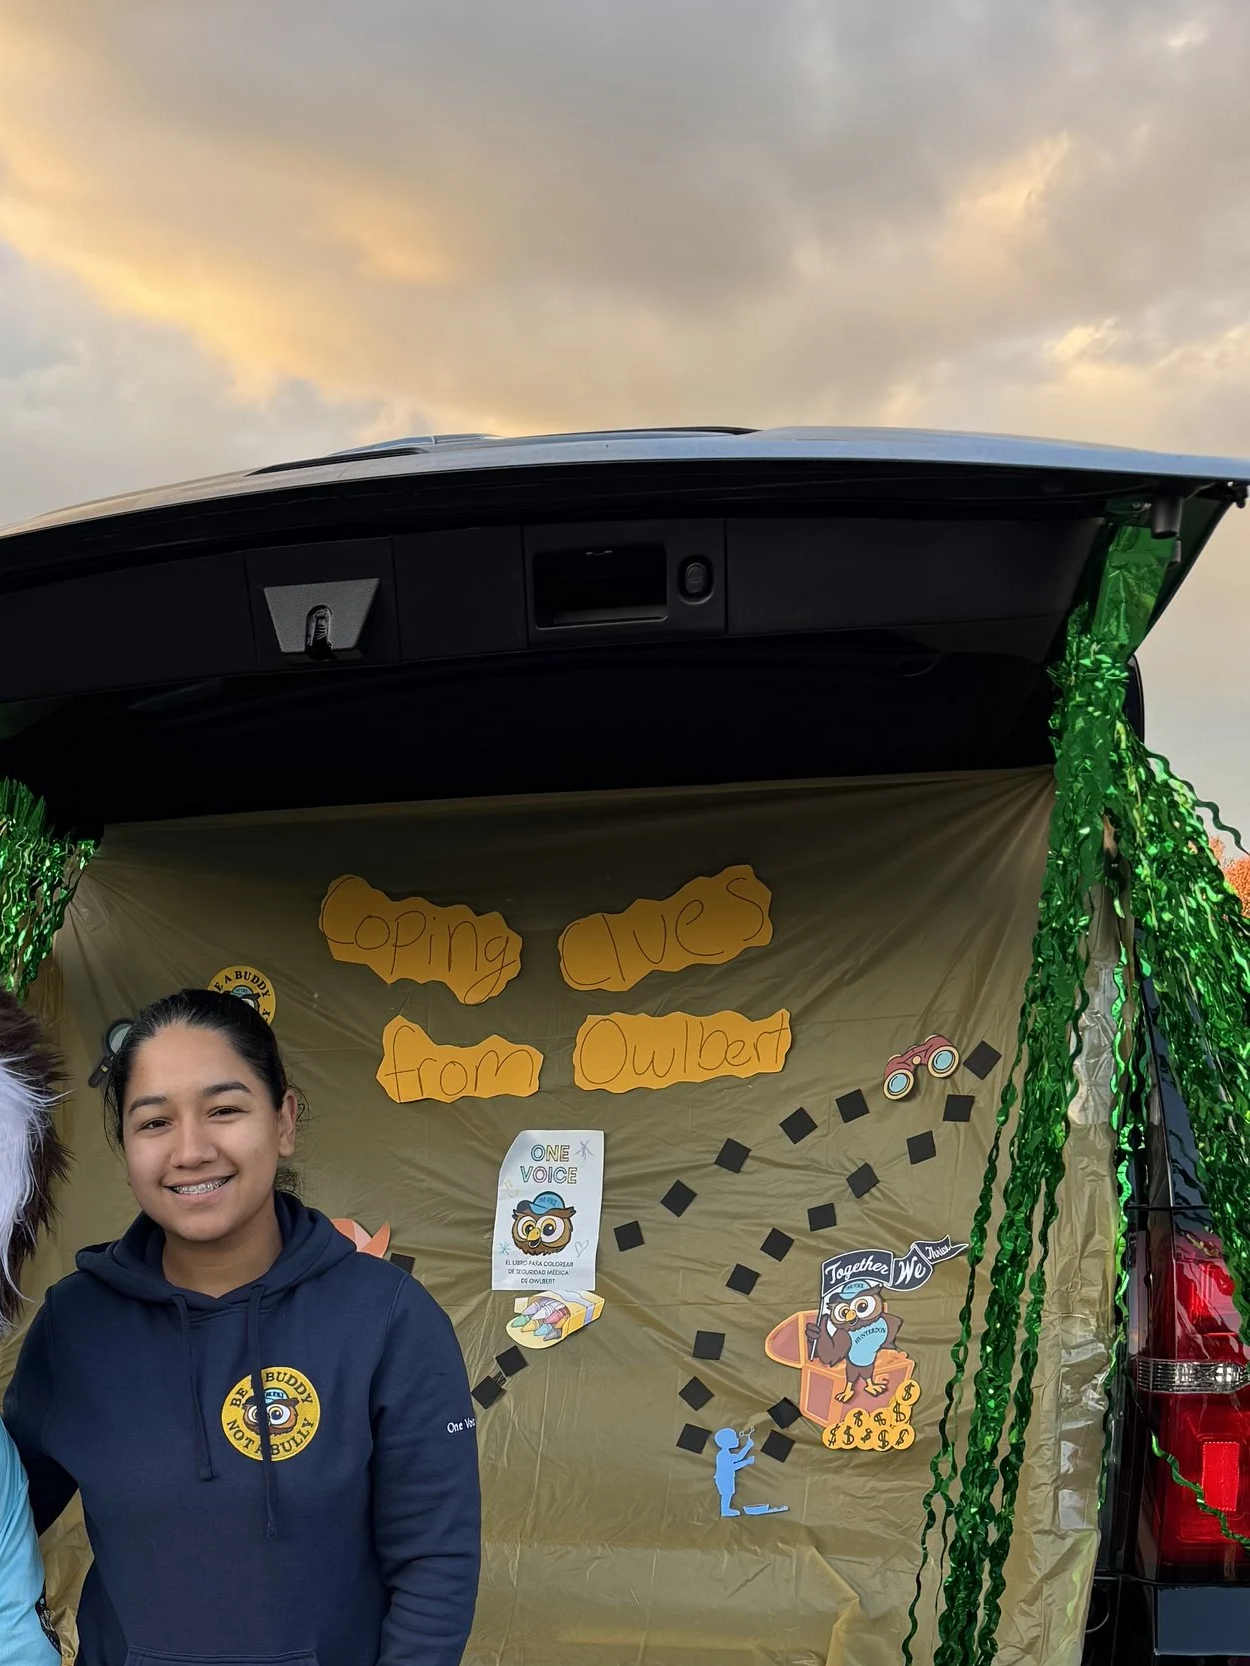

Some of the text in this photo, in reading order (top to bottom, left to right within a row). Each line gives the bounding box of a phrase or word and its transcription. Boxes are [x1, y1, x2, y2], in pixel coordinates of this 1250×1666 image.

[234, 970, 271, 998] BUDDY
[385, 1012, 790, 1103] from Owlbert
[530, 1144, 570, 1162] ONE
[520, 1166, 577, 1184] VOICE
[825, 1255, 889, 1284] Together
[894, 1256, 926, 1286] We
[855, 1327, 886, 1345] HUNTERDON
[230, 1371, 314, 1408] BE BUDDY
[227, 1418, 255, 1450] NOT
[271, 1417, 314, 1456] BULLY
[447, 1422, 463, 1433] One
